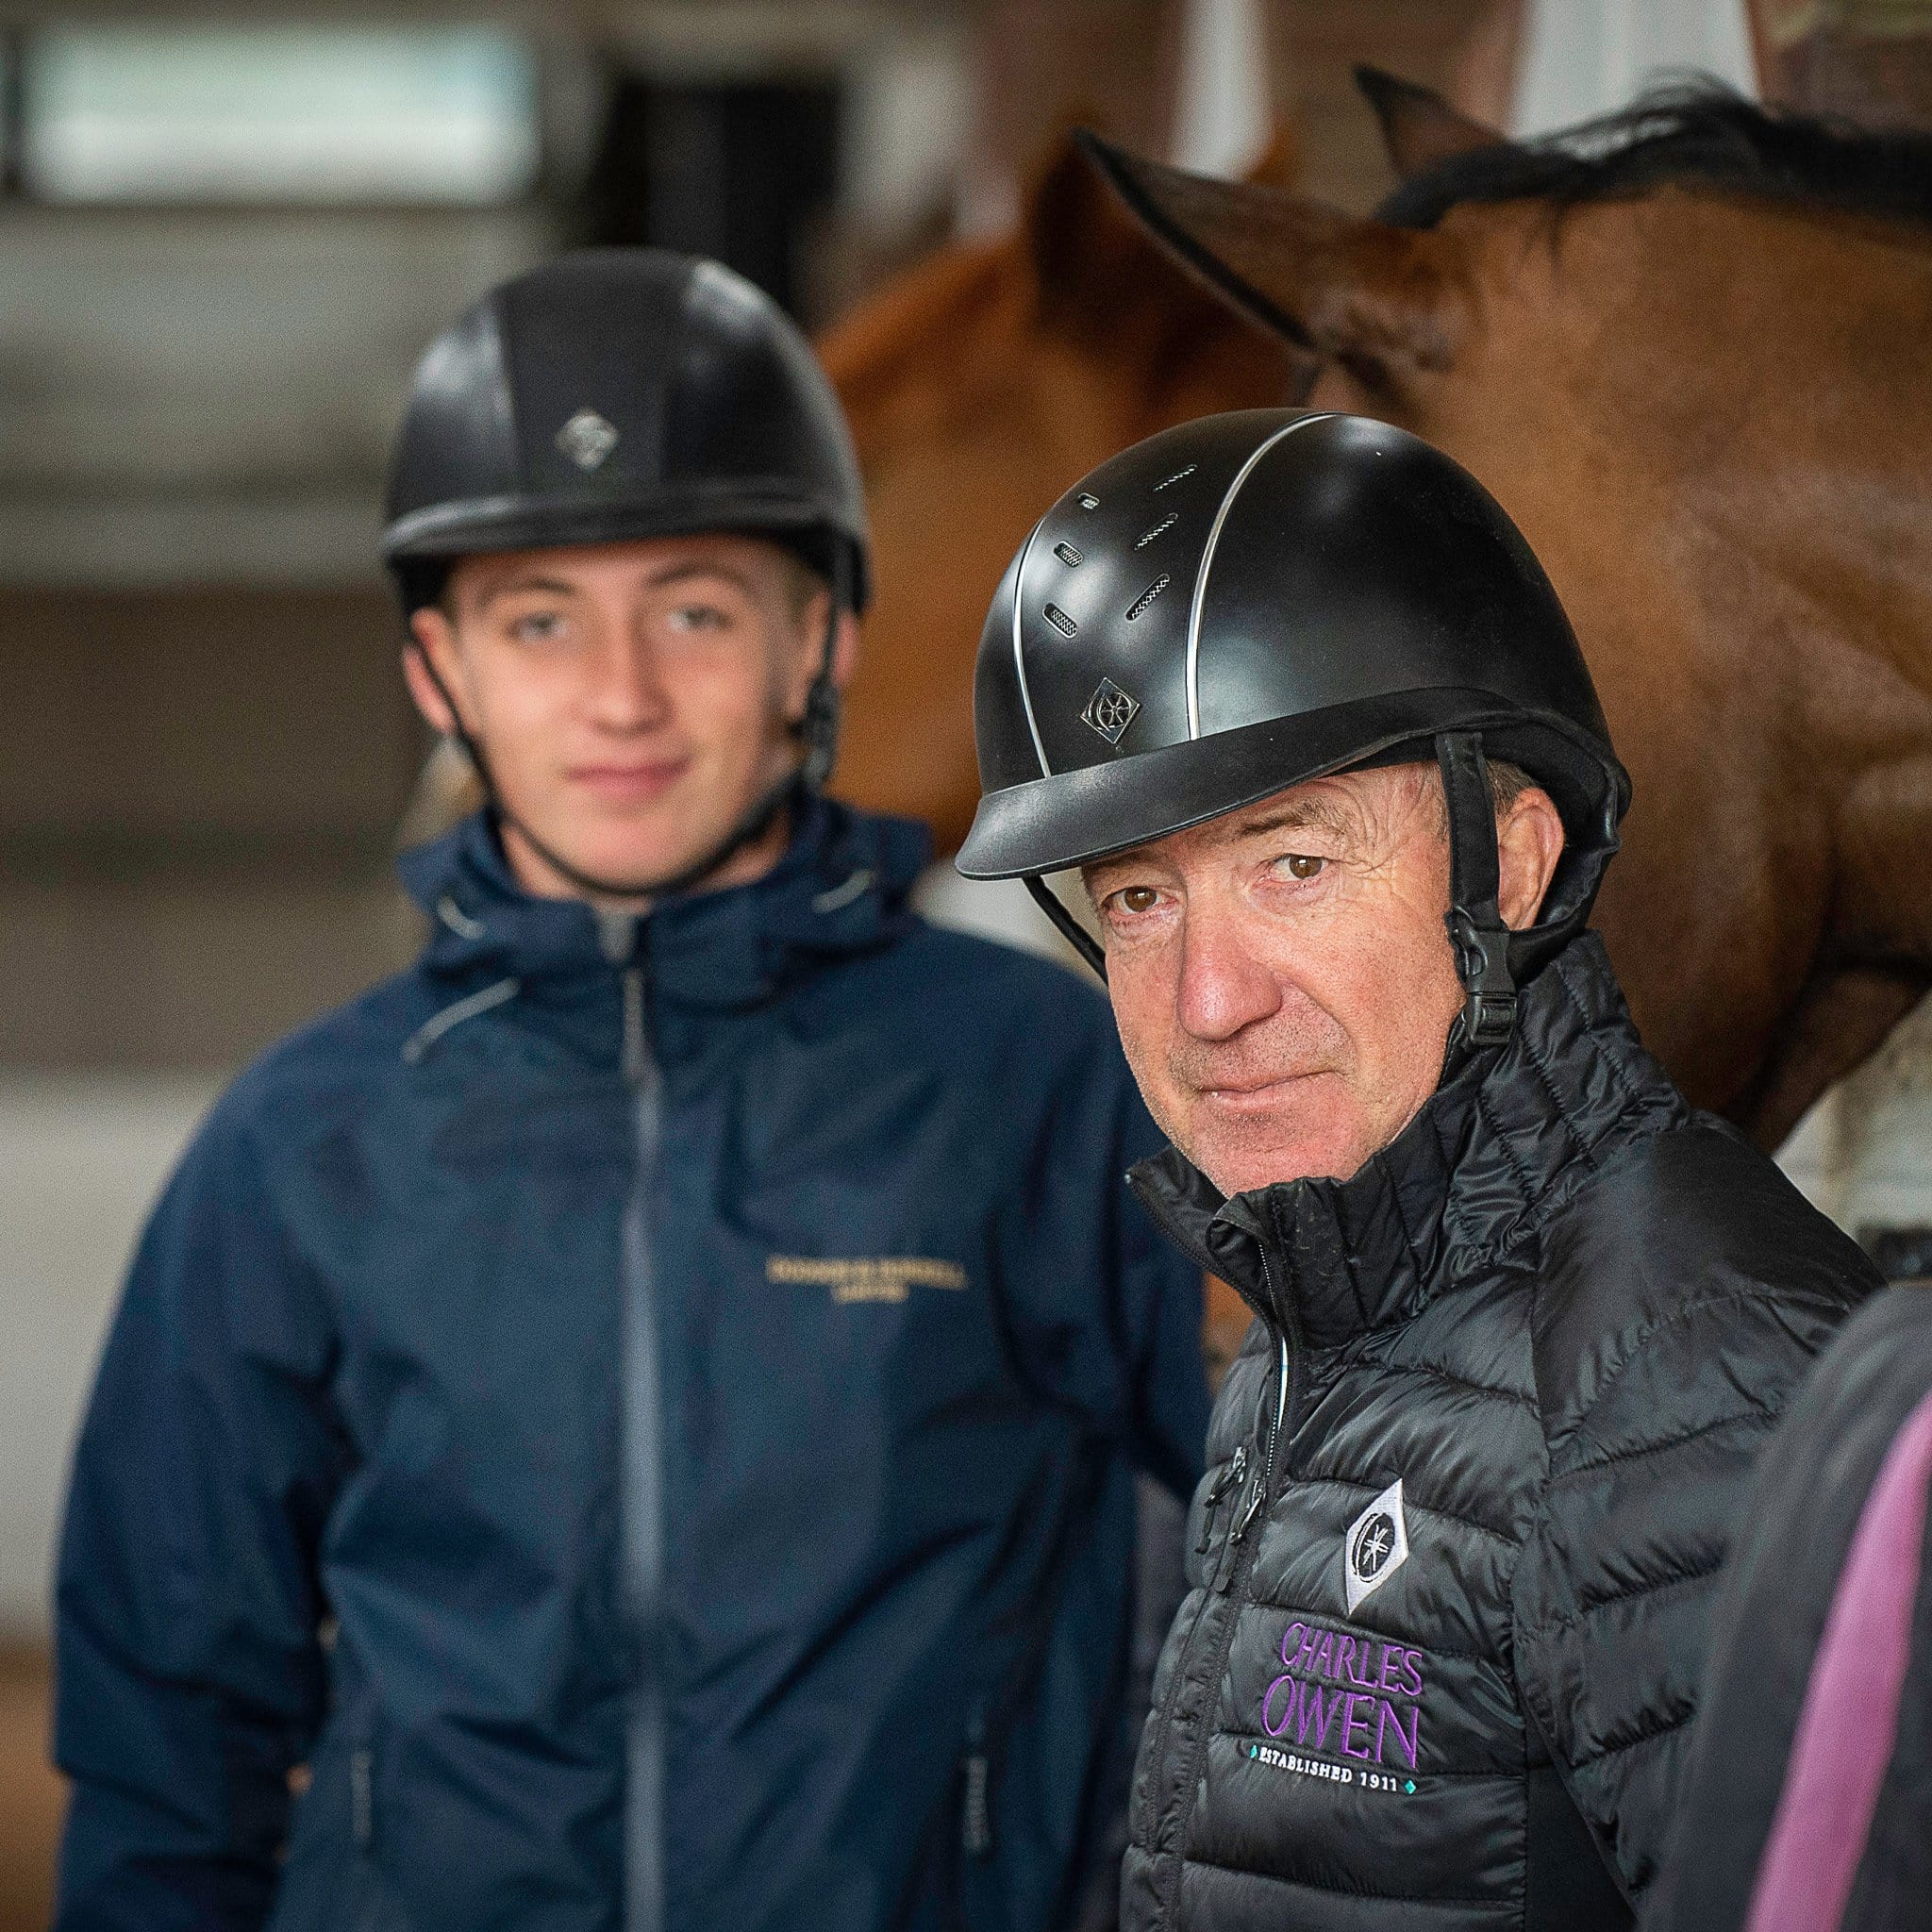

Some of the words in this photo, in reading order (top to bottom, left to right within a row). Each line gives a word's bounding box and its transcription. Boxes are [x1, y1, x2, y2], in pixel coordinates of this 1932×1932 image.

[1282, 1623, 1423, 1695] CHARLES
[1263, 1675, 1419, 1768] OWEN
[1258, 1746, 1353, 1783] ESTABLISHED
[1360, 1773, 1397, 1791] 1911
